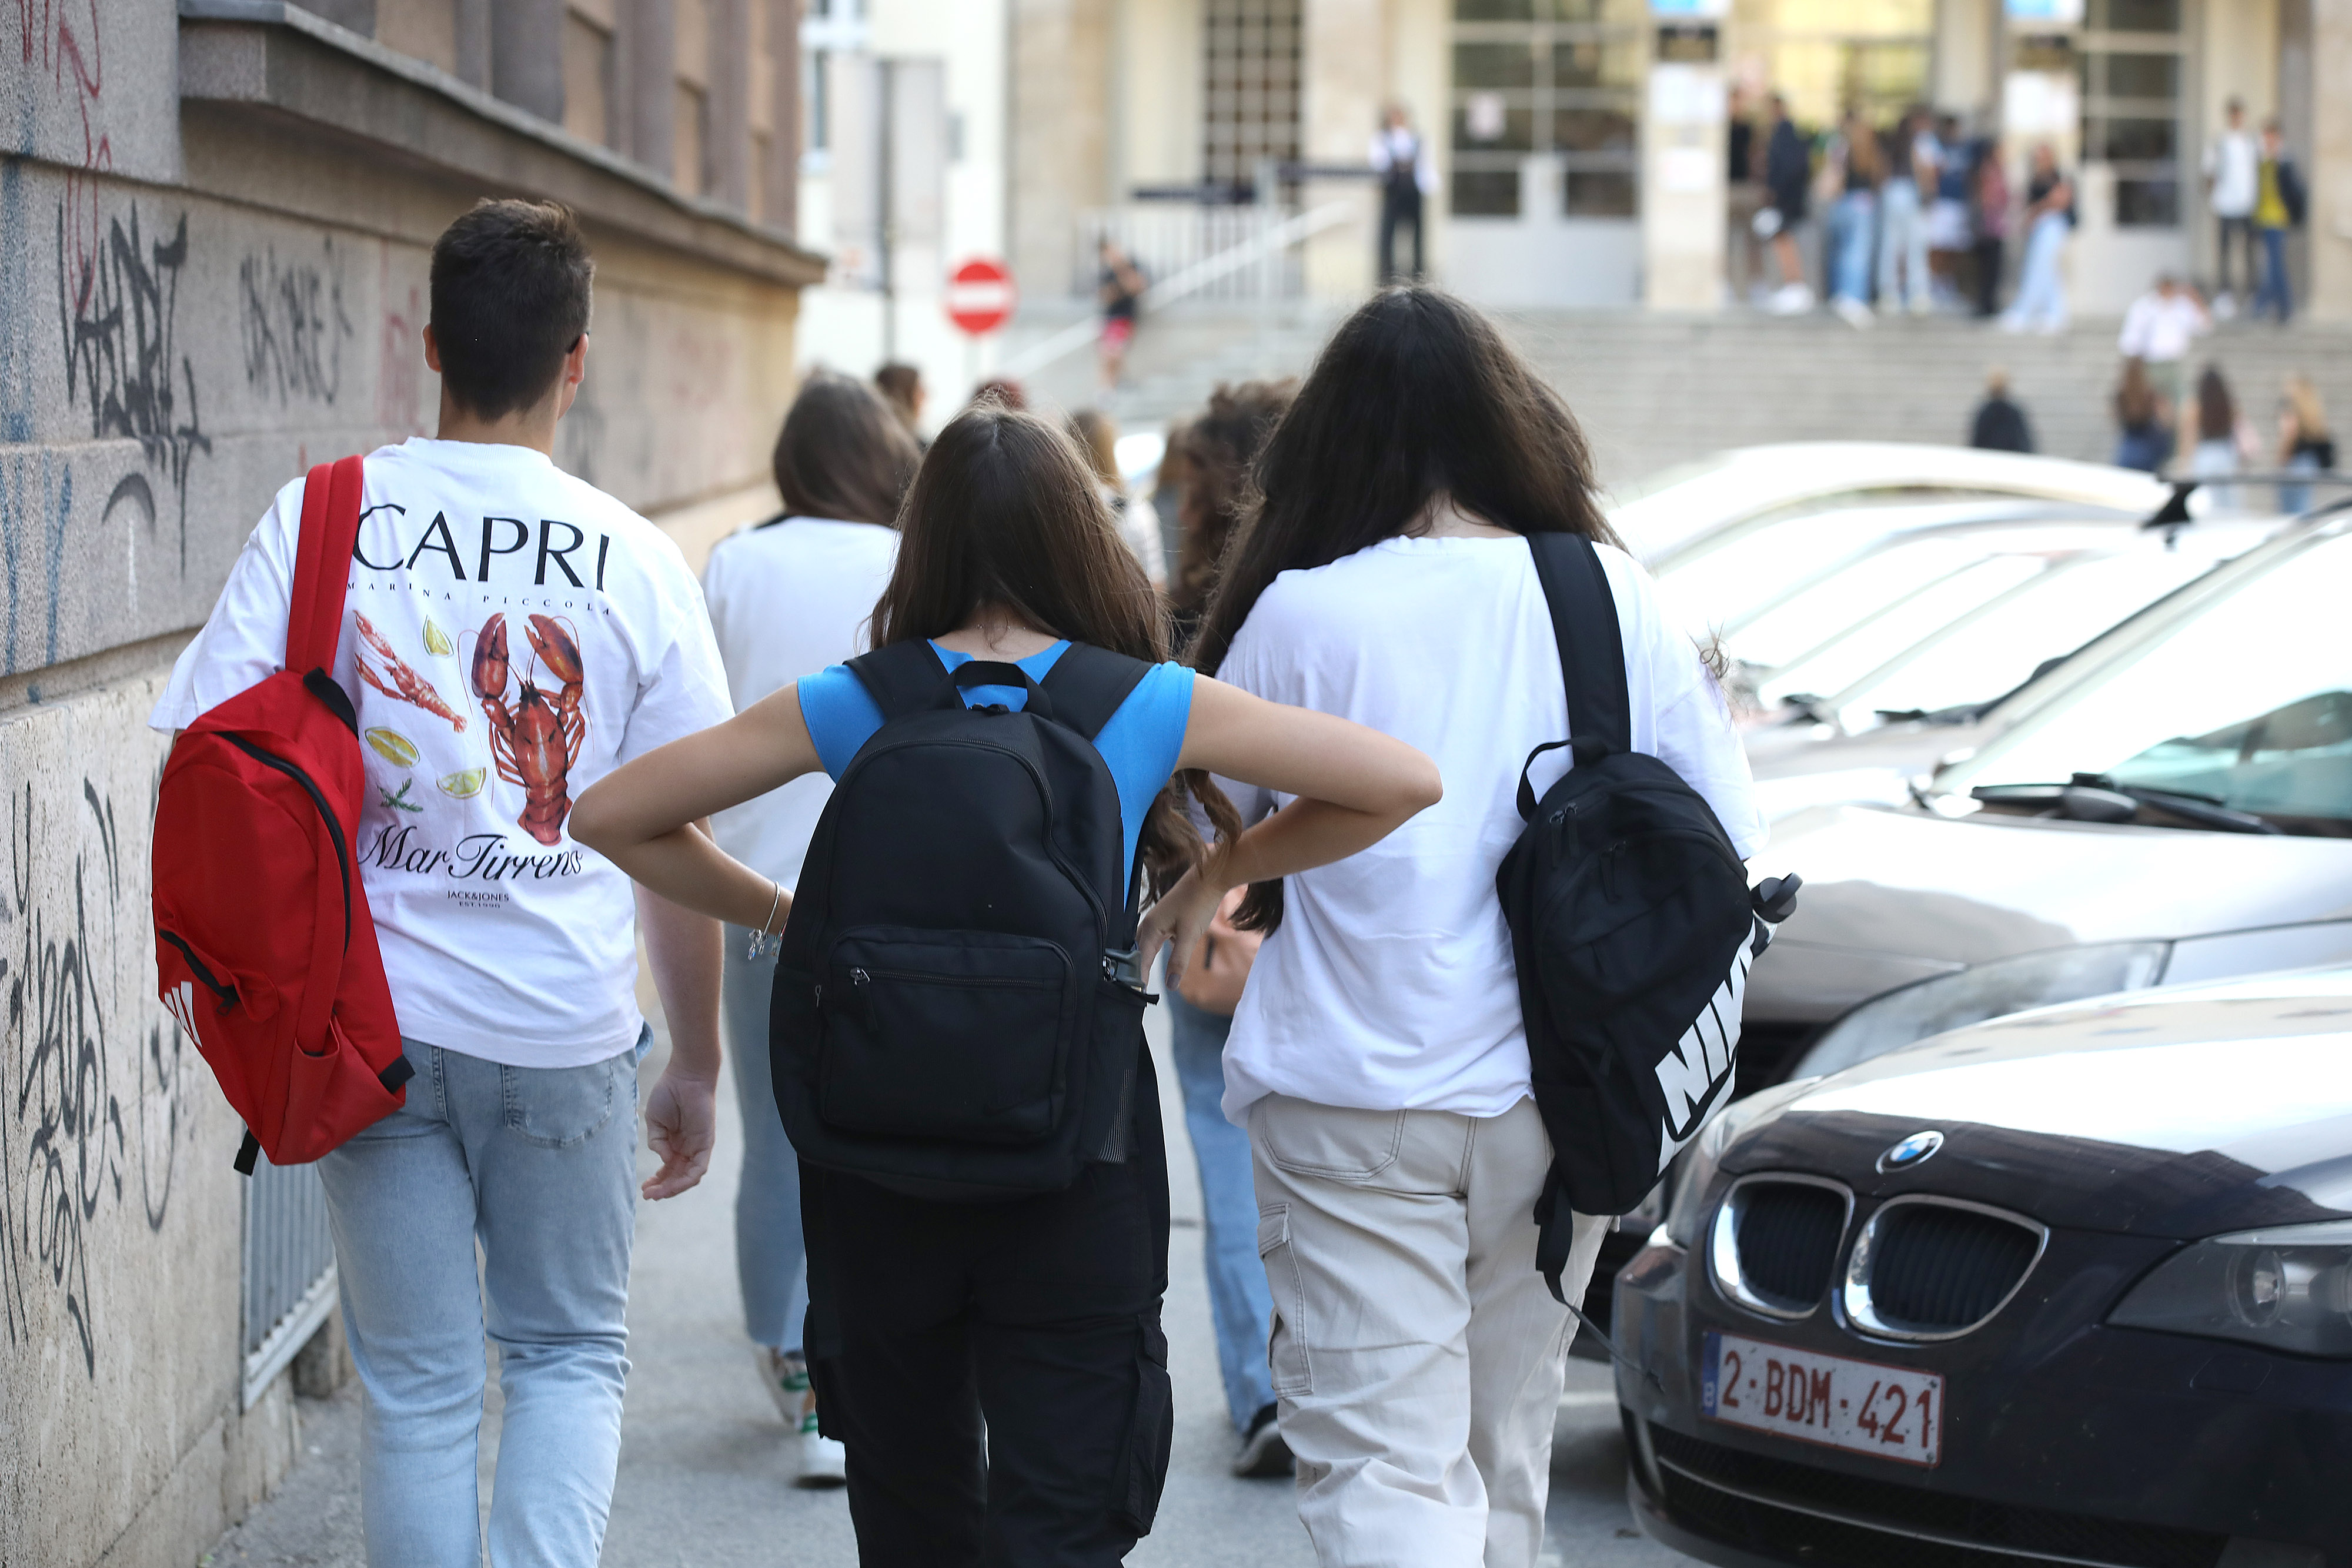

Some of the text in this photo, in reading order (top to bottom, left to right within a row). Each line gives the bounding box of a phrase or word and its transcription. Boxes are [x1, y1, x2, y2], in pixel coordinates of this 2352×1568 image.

[352, 503, 610, 593] CAPRI
[348, 583, 610, 616] MARINA PICCOLA
[358, 825, 451, 875] Mar
[447, 890, 509, 902] JACK&JONES
[1655, 917, 1755, 1135] NIK
